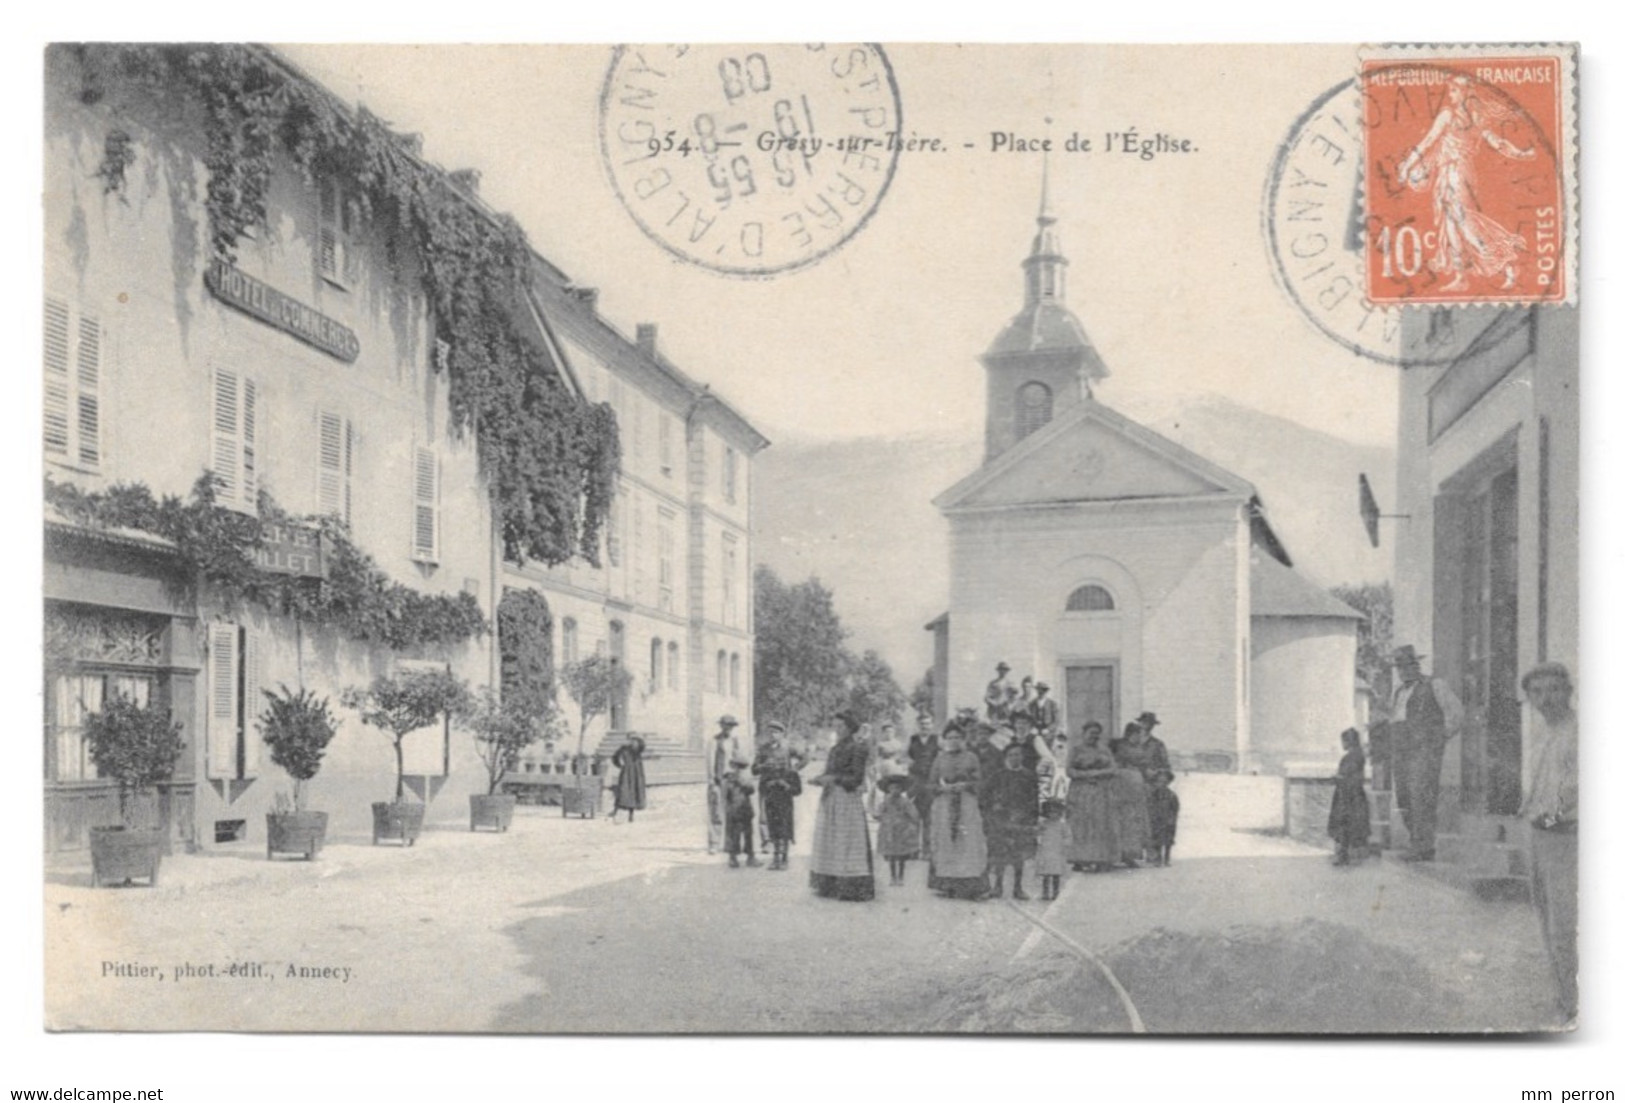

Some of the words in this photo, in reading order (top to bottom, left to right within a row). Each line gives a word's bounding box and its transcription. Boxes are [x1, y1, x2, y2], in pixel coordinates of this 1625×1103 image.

[1475, 66, 1552, 86] FRANÇAISE
[648, 130, 700, 159] 954.
[990, 131, 1053, 153] Place
[1064, 132, 1091, 153] de
[1104, 126, 1199, 161] l'Église.
[1536, 206, 1556, 287] POSTES
[100, 960, 165, 982] Pittier,
